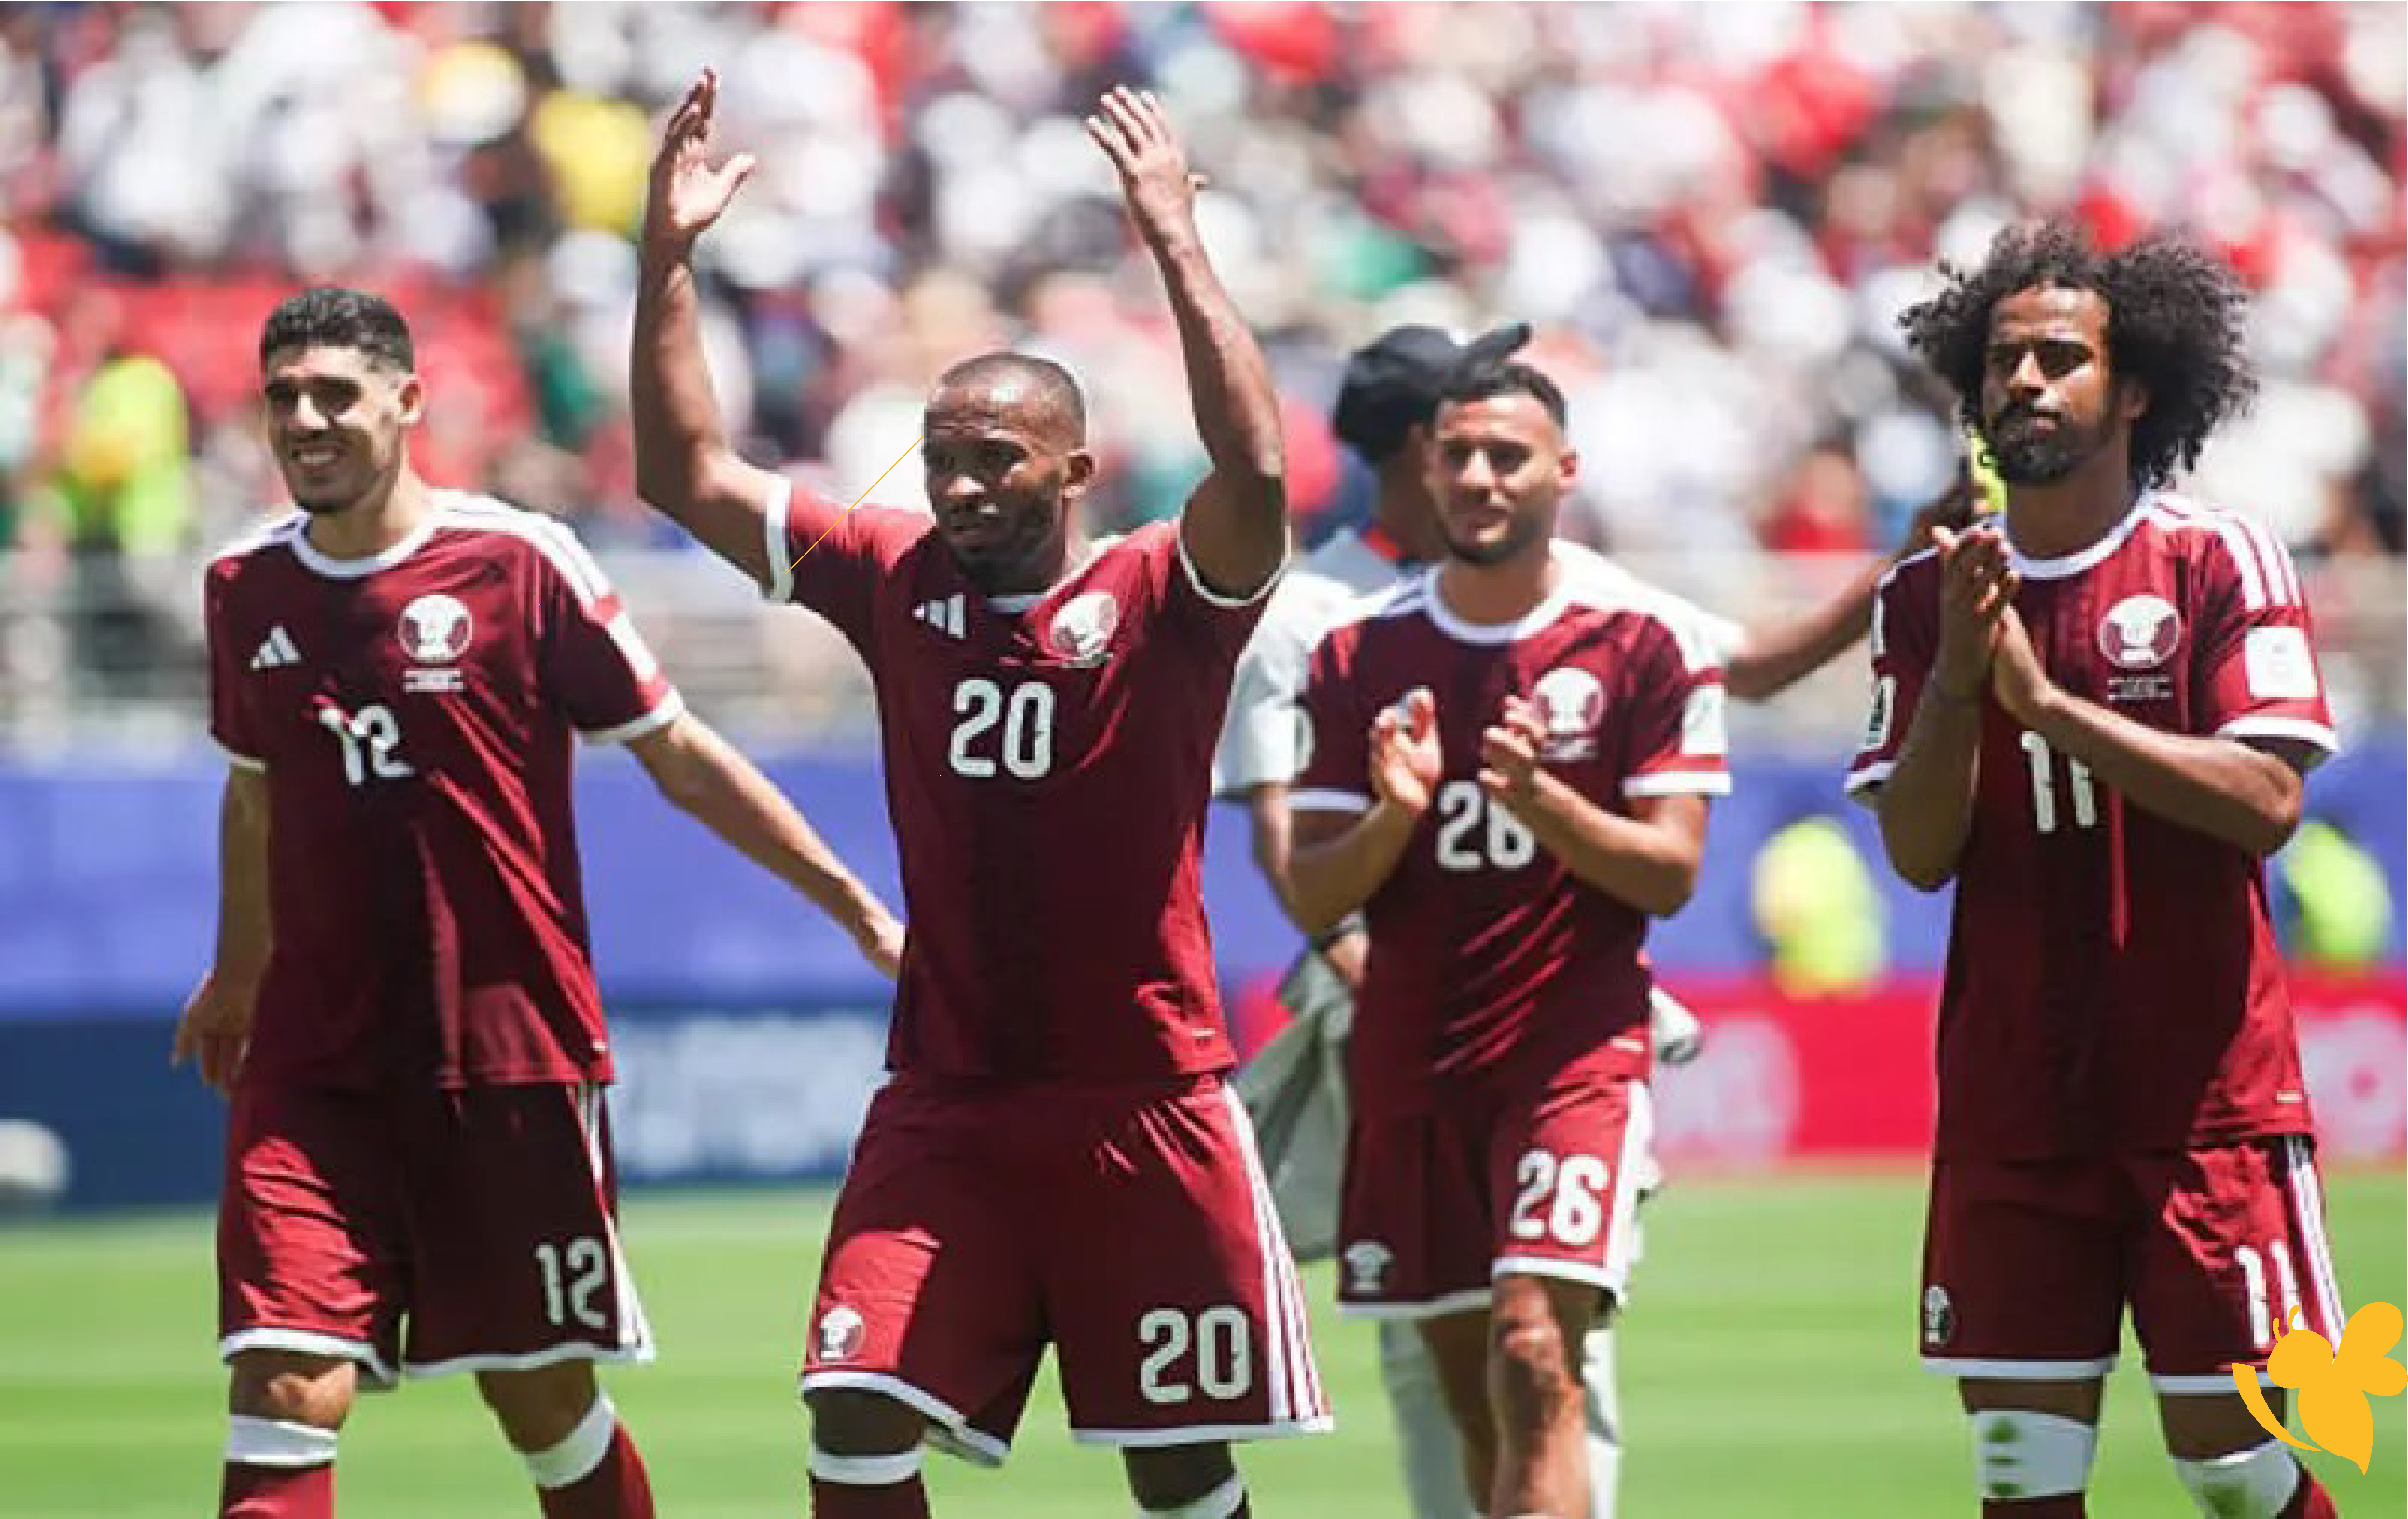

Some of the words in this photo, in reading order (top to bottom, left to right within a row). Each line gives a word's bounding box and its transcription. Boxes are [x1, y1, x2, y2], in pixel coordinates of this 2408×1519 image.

[319, 705, 413, 783] 12
[951, 681, 1055, 778] 20
[1437, 781, 1534, 869] 26
[1510, 1150, 1609, 1245] 26
[536, 1238, 606, 1327] 12
[1139, 1307, 1252, 1401] 20
